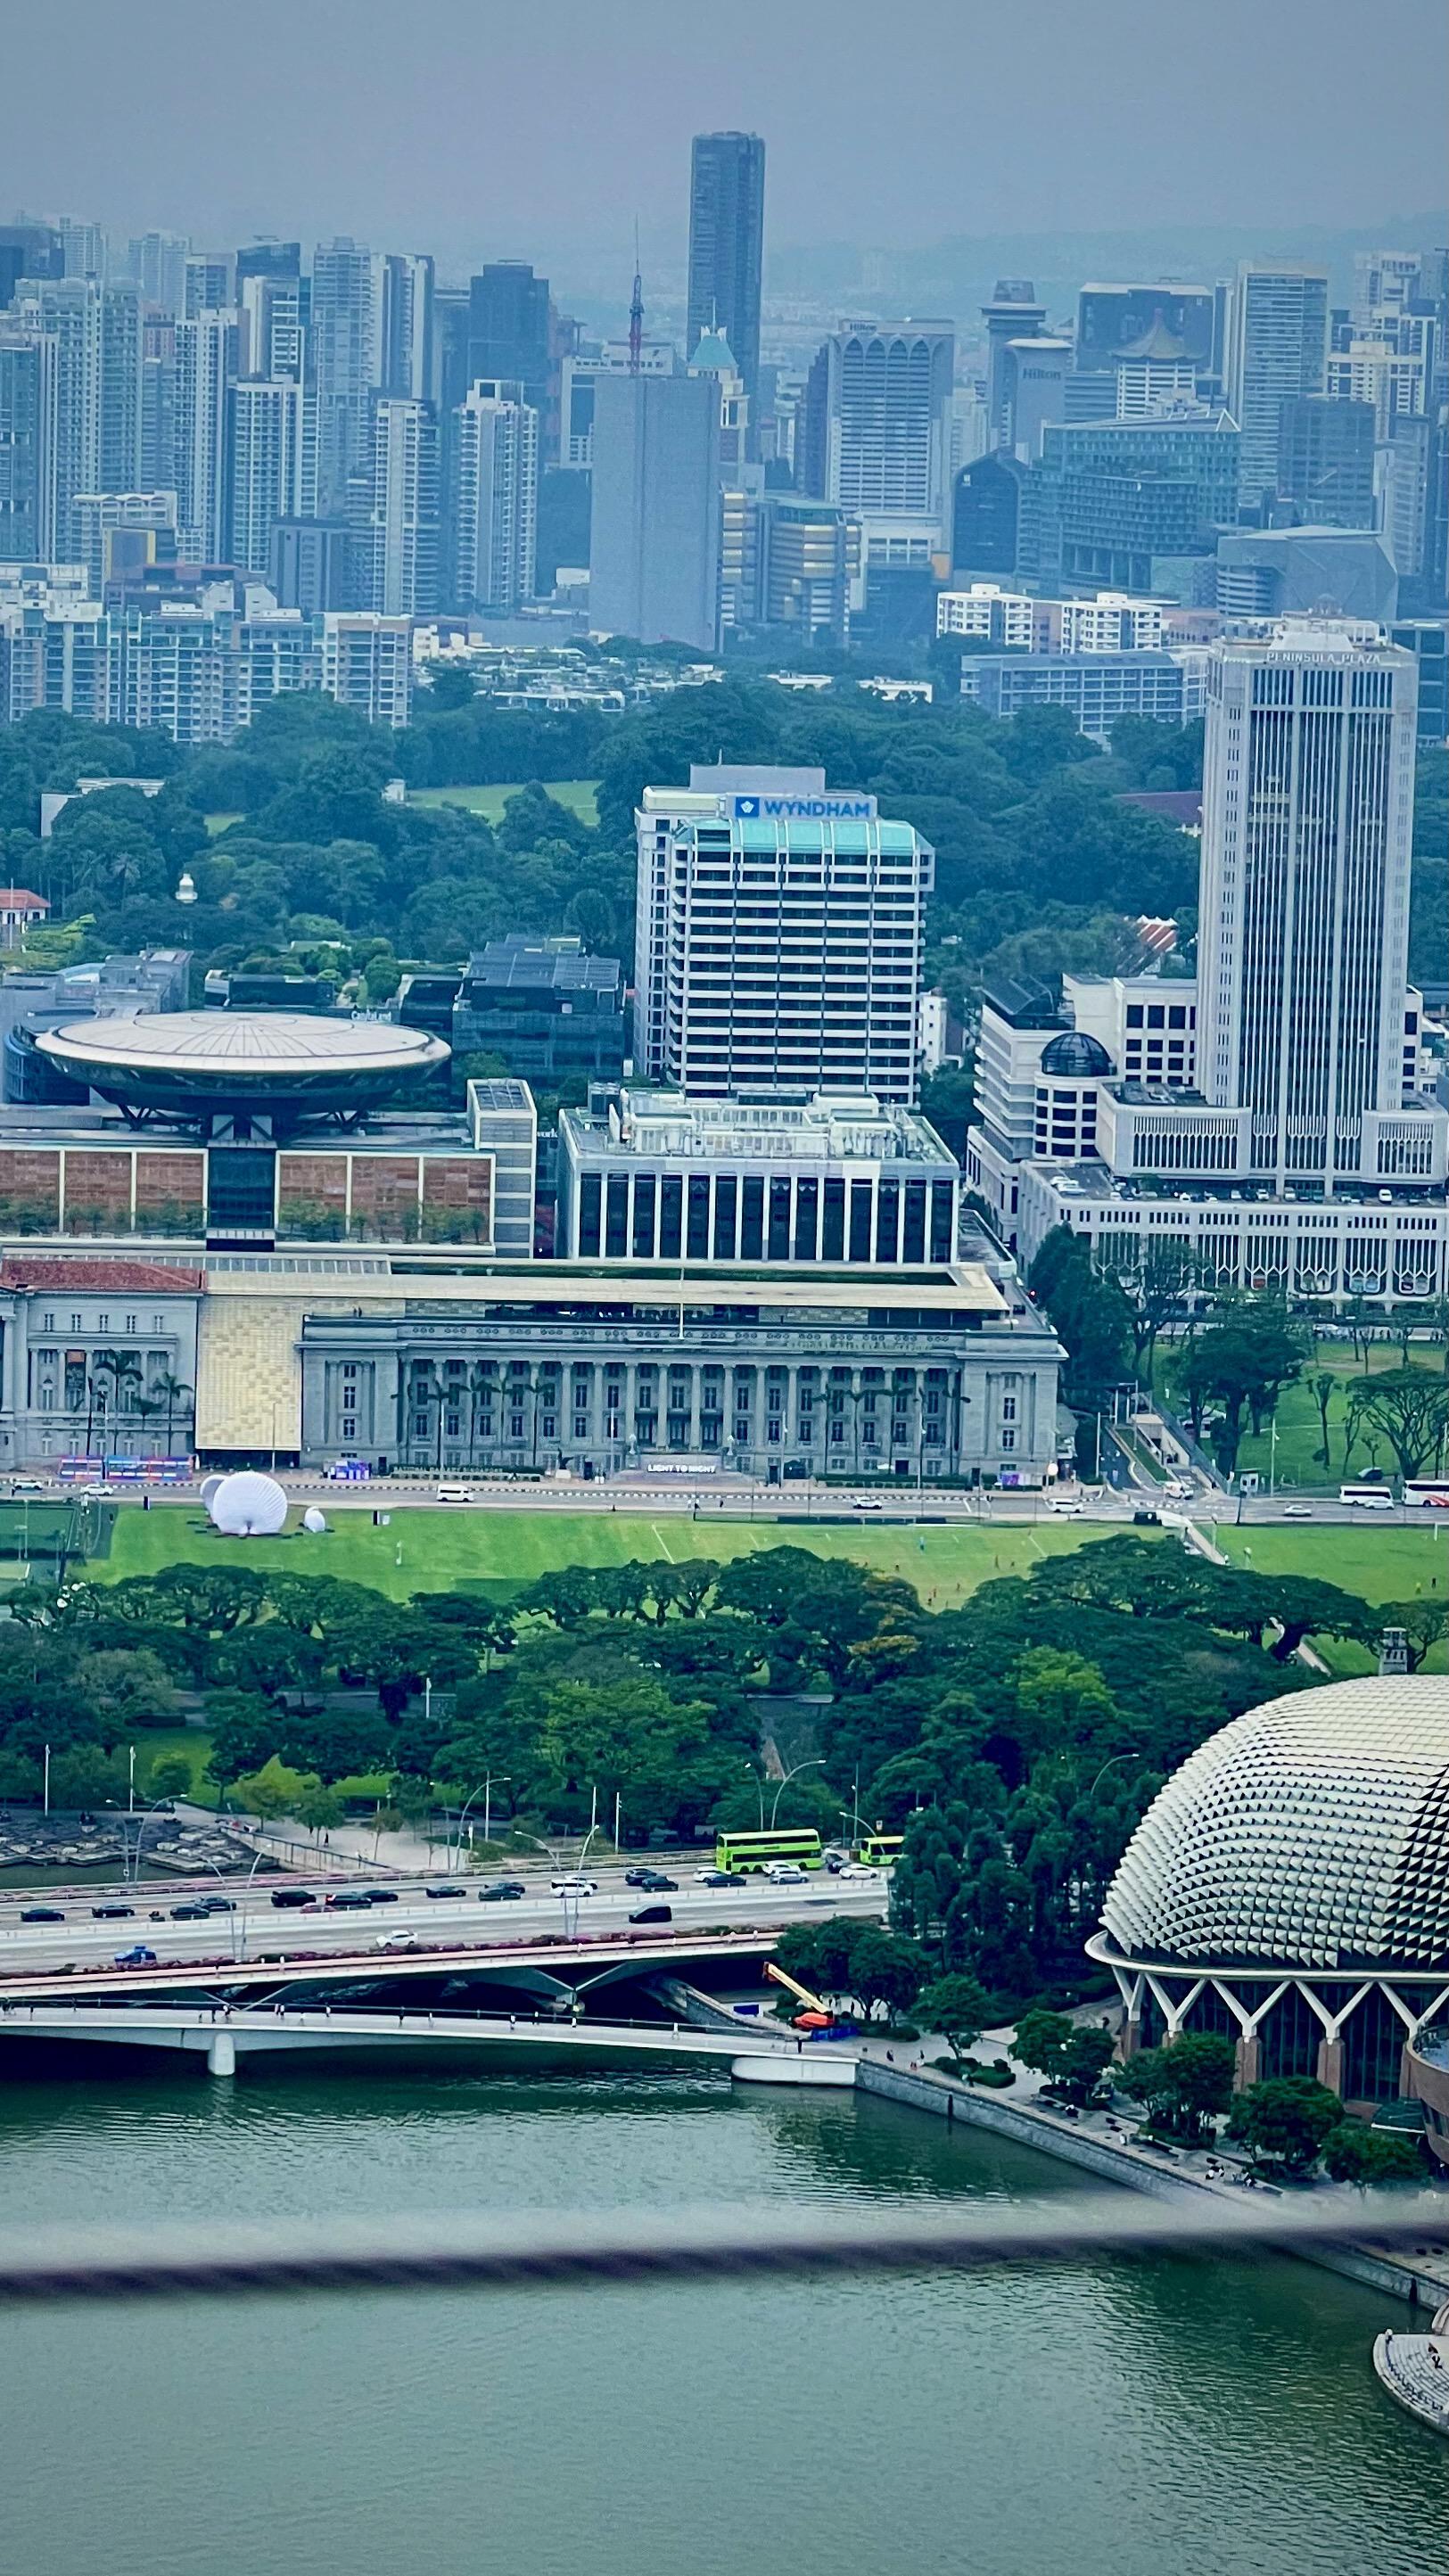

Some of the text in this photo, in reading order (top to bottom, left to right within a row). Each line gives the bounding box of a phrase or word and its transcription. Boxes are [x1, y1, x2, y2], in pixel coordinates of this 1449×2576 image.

[1022, 366, 1061, 381] Hilton
[1266, 651, 1380, 664] PENINSULA PLAZA
[763, 800, 870, 818] WYNDHAM
